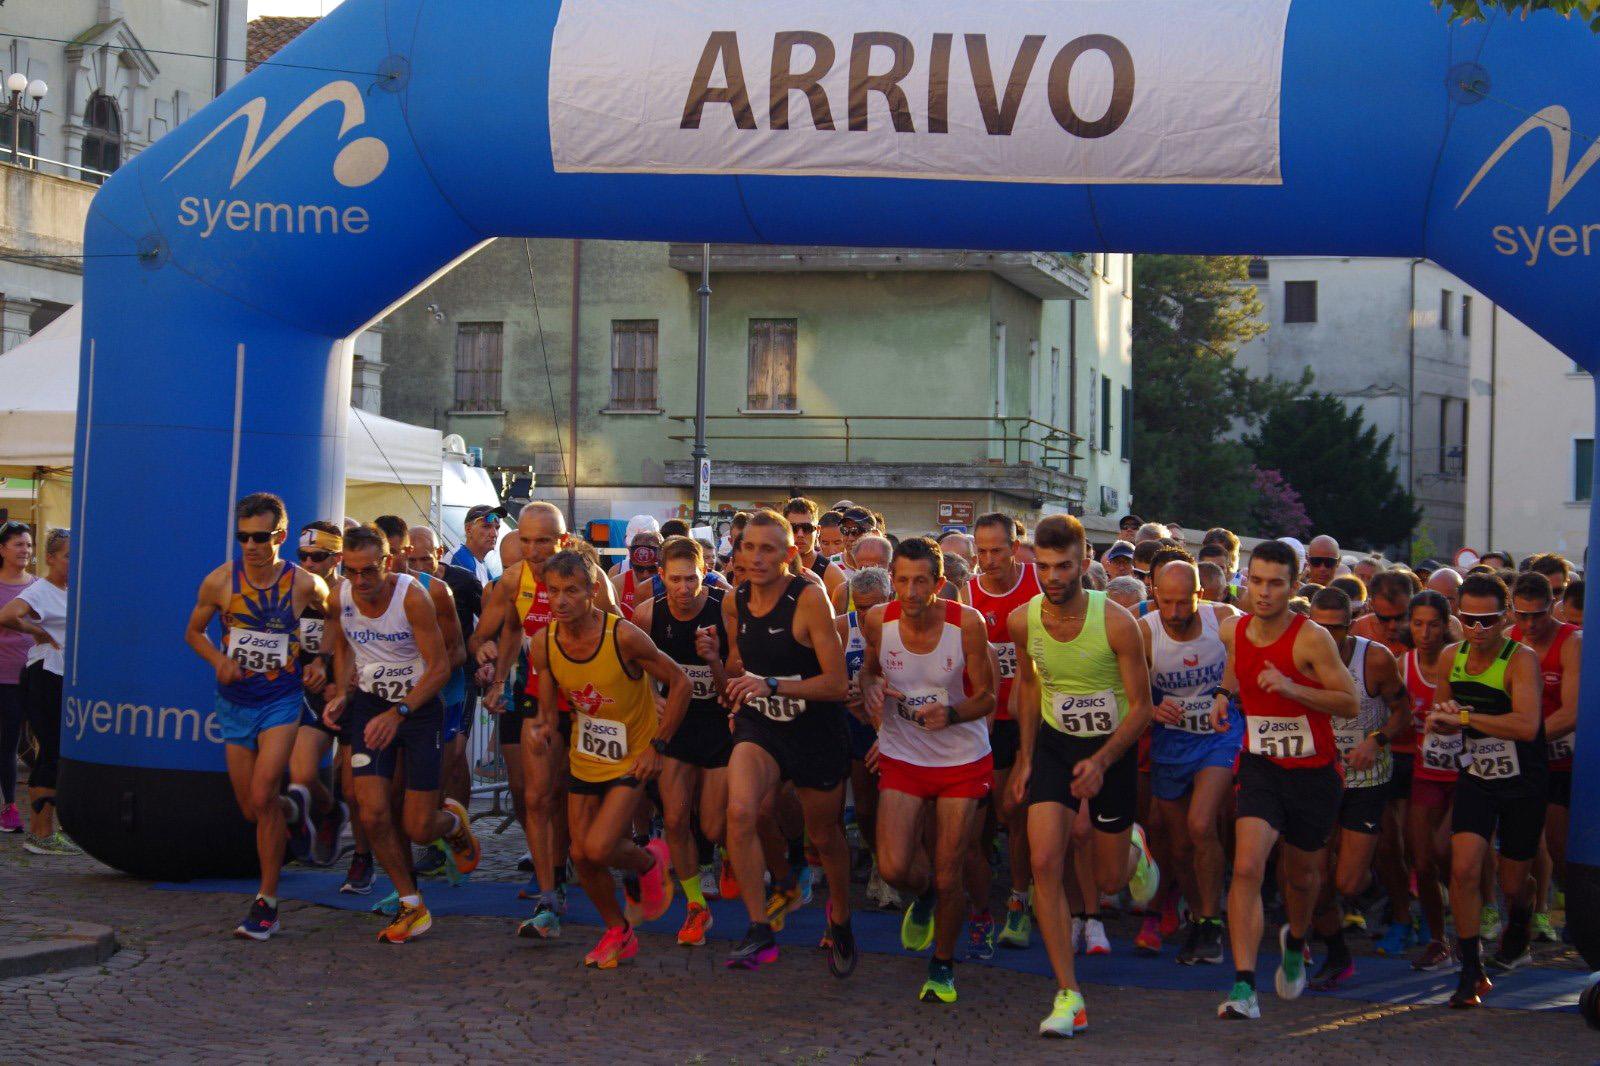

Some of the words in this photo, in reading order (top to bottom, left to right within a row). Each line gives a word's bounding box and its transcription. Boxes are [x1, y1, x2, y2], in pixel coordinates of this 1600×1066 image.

[680, 30, 1136, 139] ARRIVO
[178, 196, 370, 239] syemme
[252, 639, 279, 649] asics
[232, 647, 282, 671] 635
[386, 666, 414, 677] asics
[907, 694, 938, 706] asics
[1075, 697, 1106, 708] asics
[1185, 701, 1212, 711] asics
[65, 696, 225, 744] syemme
[1061, 711, 1113, 733] 513
[591, 725, 618, 738] asics
[1271, 722, 1300, 732] asics
[581, 732, 623, 760] 620
[1259, 735, 1304, 757] 517
[1334, 736, 1354, 745] sics
[1479, 743, 1505, 755] asics
